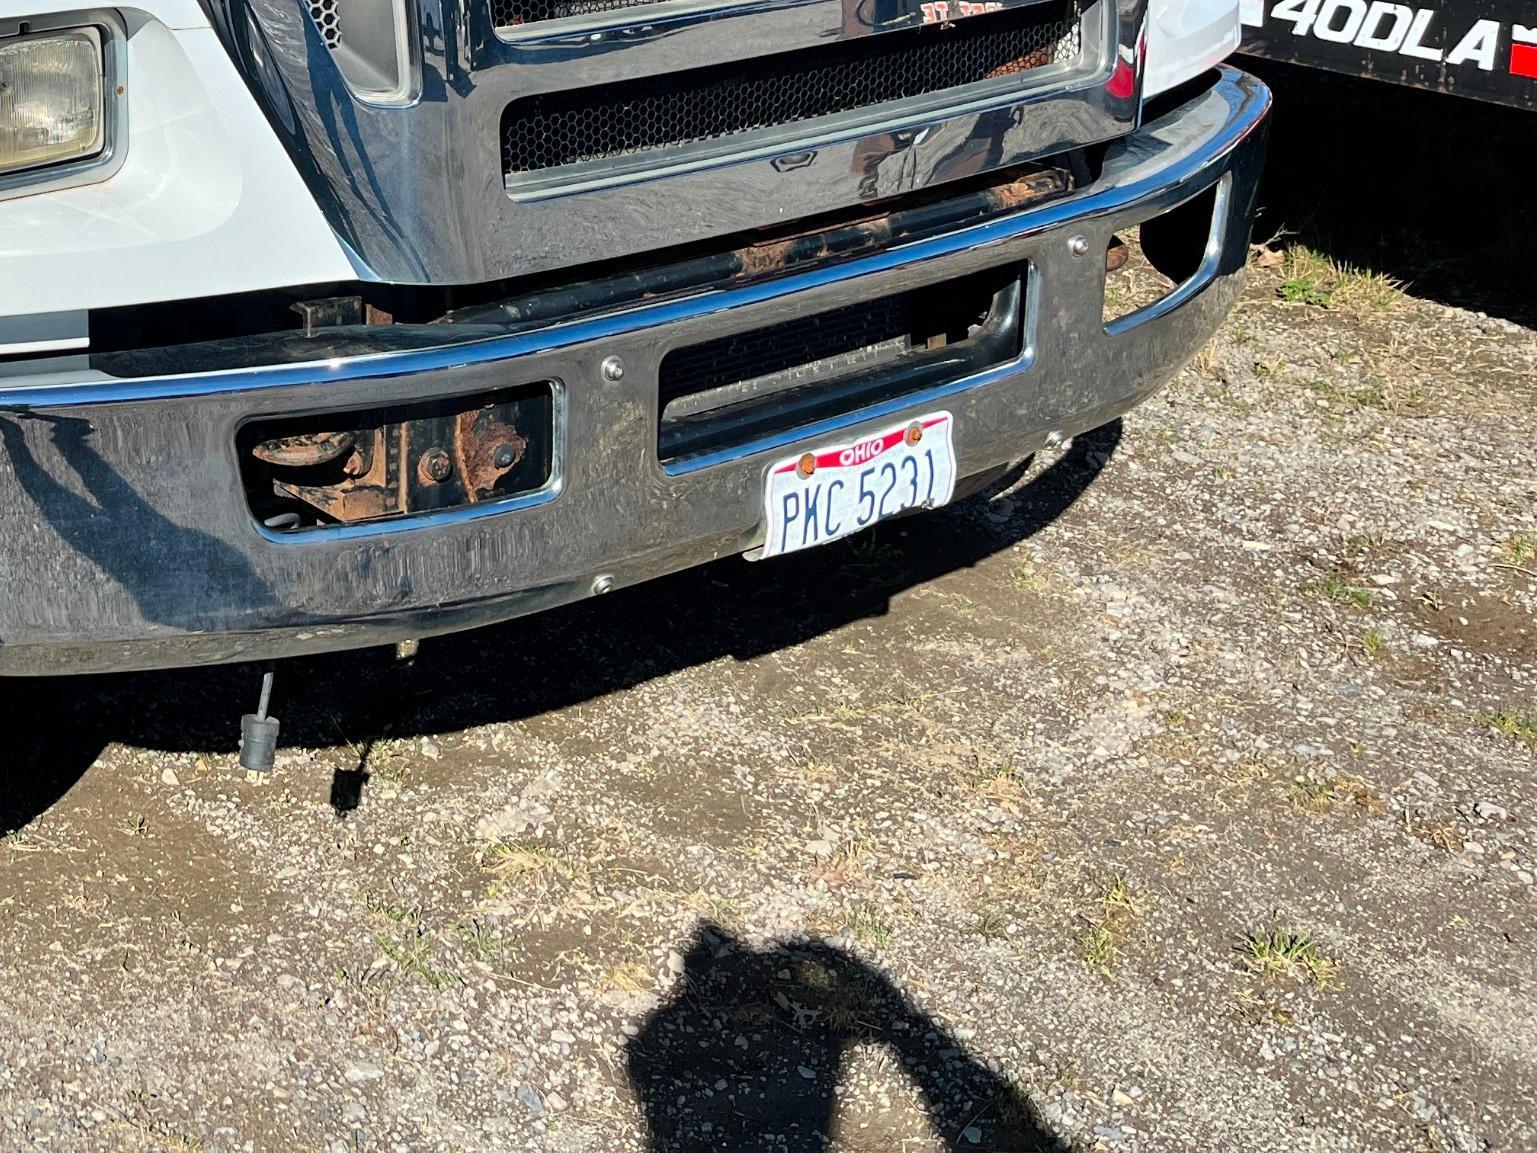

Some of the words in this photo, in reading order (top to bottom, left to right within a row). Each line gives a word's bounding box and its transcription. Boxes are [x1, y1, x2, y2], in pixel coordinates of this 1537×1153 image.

[839, 438, 884, 466] OHIO
[781, 479, 845, 553] PKC
[856, 448, 935, 526] 5231
